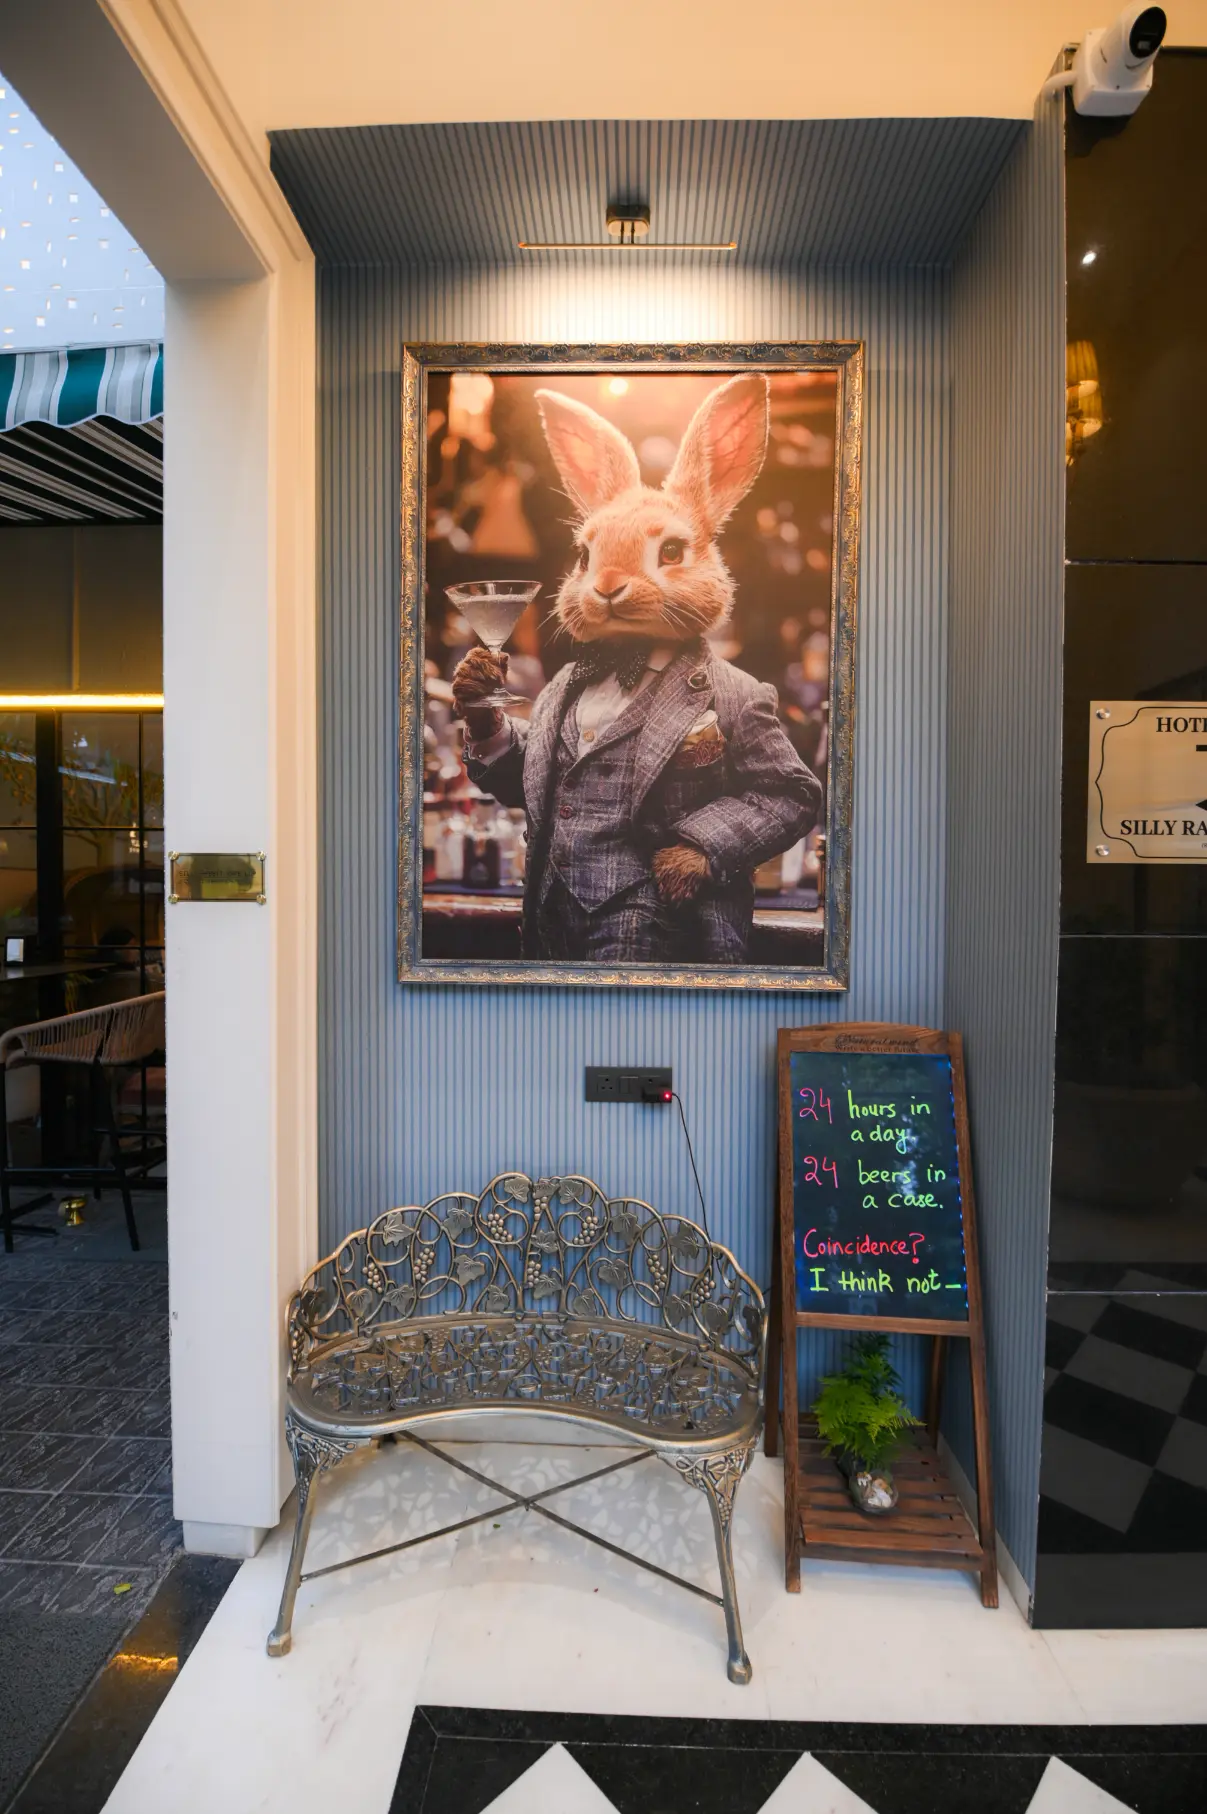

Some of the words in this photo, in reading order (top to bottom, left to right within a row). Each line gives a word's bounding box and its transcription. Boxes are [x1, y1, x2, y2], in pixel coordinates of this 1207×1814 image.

[1120, 820, 1177, 835] SILLY
[800, 1087, 832, 1124] 24
[847, 1089, 896, 1119] hours
[911, 1096, 930, 1115] in
[851, 1129, 864, 1142] a
[804, 1156, 838, 1188] 24
[858, 1159, 912, 1185] beers
[927, 1164, 946, 1182] in
[862, 1194, 878, 1209] a
[888, 1193, 944, 1209] case.
[803, 1228, 925, 1264] Coincidence?
[810, 1268, 829, 1291] I
[838, 1270, 893, 1292] think
